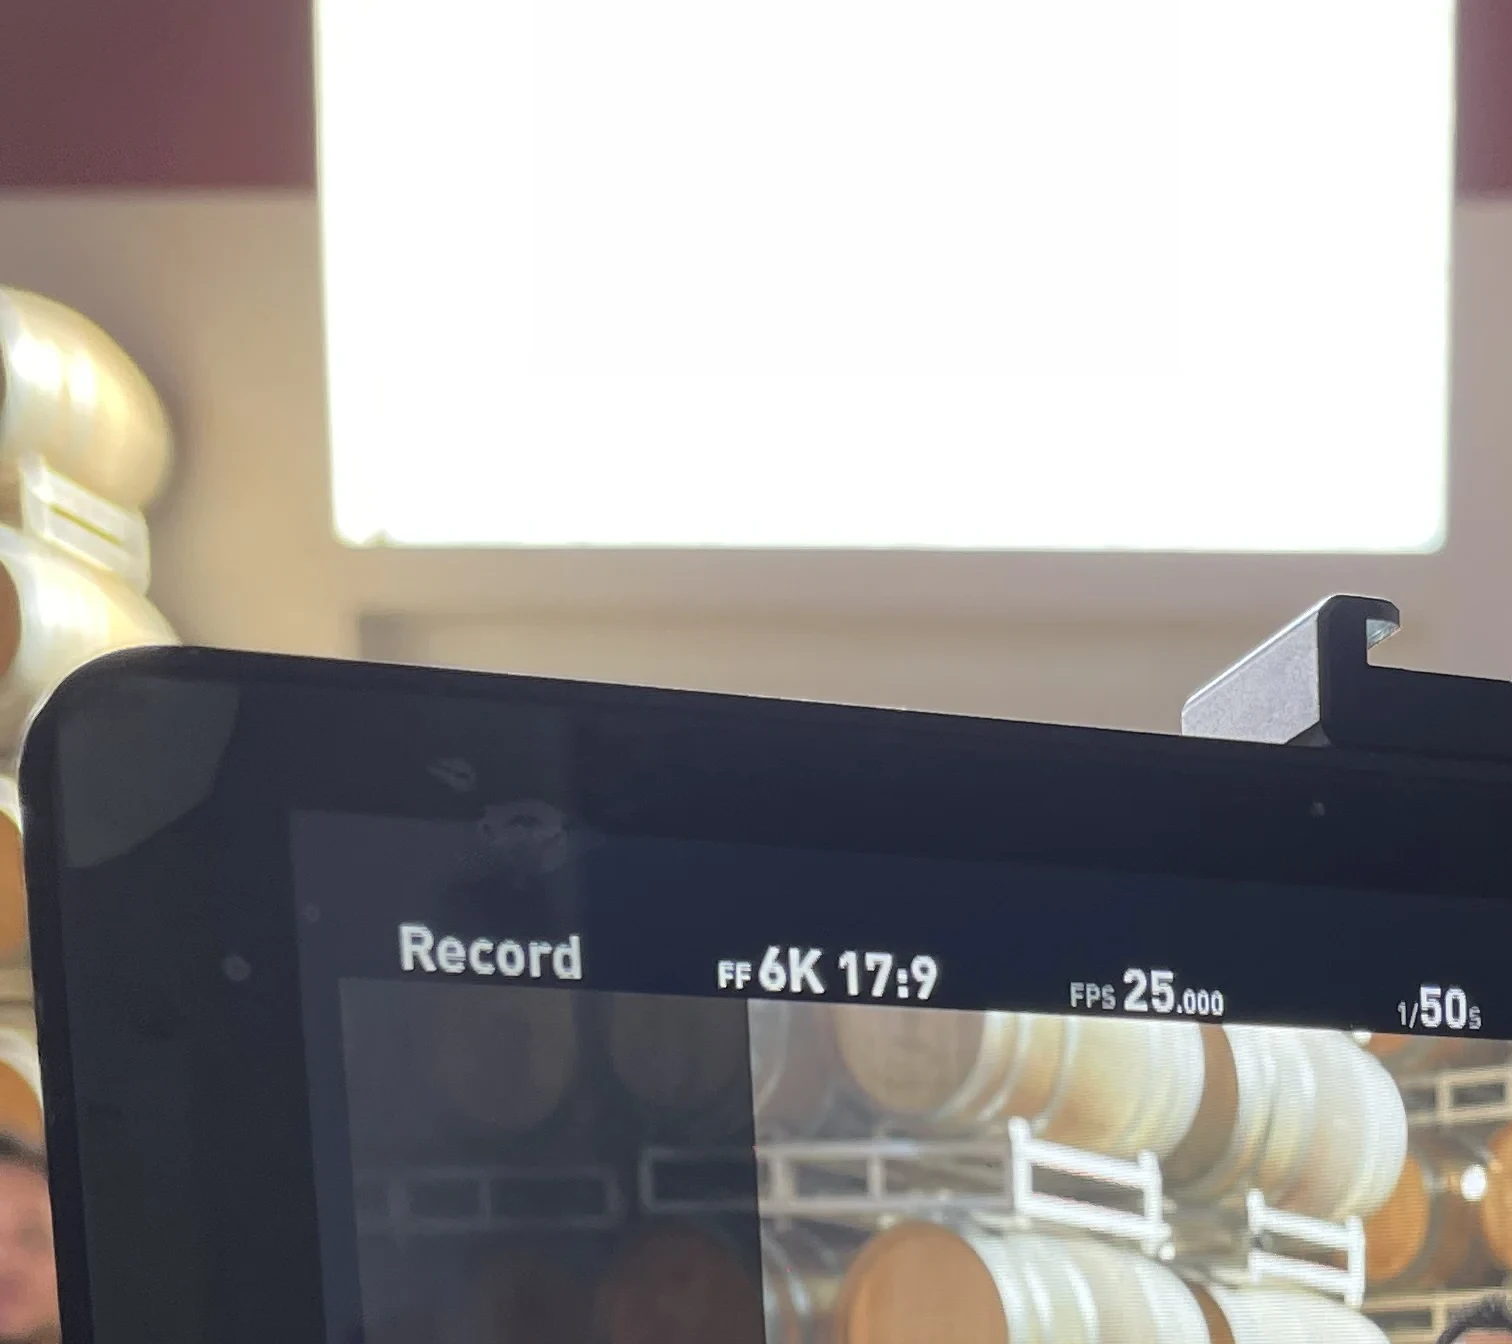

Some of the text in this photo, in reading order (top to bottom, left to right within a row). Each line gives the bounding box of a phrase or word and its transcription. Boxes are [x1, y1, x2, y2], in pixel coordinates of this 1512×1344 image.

[399, 925, 583, 981] Record
[717, 946, 938, 999] FF 6K 17:9
[1070, 968, 1225, 1017] FPS 25.000
